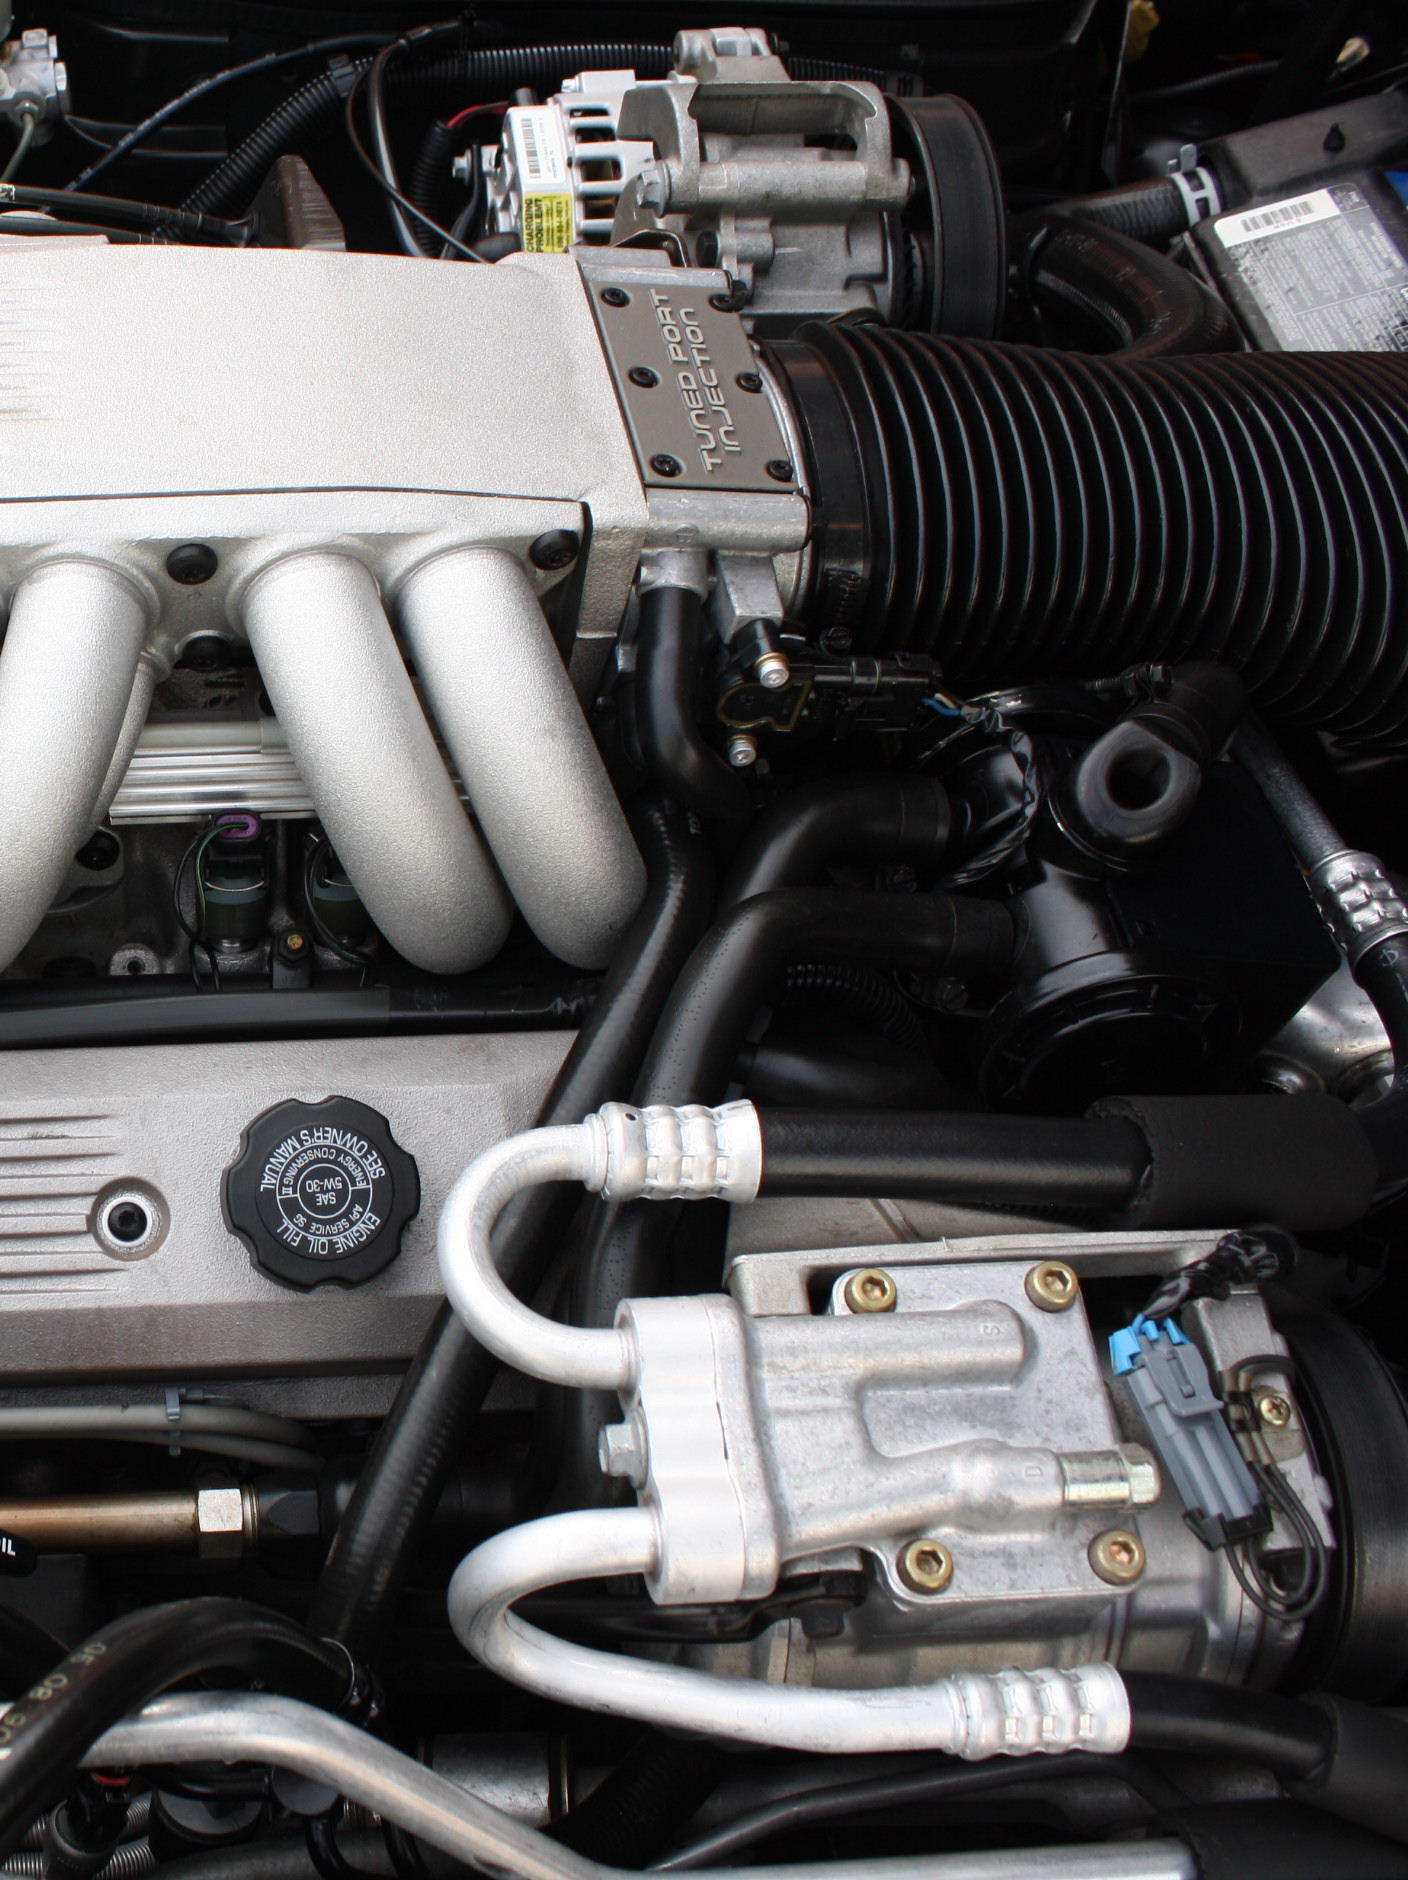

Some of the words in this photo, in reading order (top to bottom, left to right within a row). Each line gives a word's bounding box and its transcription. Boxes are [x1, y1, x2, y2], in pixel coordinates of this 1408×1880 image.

[524, 198, 535, 252] CHARGING
[648, 288, 689, 363] PORT
[679, 307, 741, 454] INJECTION
[677, 371, 722, 472] TUNED
[300, 1127, 368, 1154] OWNER'S
[260, 1136, 300, 1192] MANUAL
[282, 1147, 336, 1186] CONSERVING
[338, 1154, 367, 1187] ENERGY
[362, 1149, 385, 1179] SEE
[306, 1176, 342, 1192] 5W-30
[316, 1192, 337, 1206] SAE
[309, 1218, 350, 1234] SERVICE
[349, 1203, 364, 1222] API
[276, 1218, 303, 1247] FILL
[308, 1238, 328, 1254] OIL
[333, 1212, 381, 1254] ENGINE
